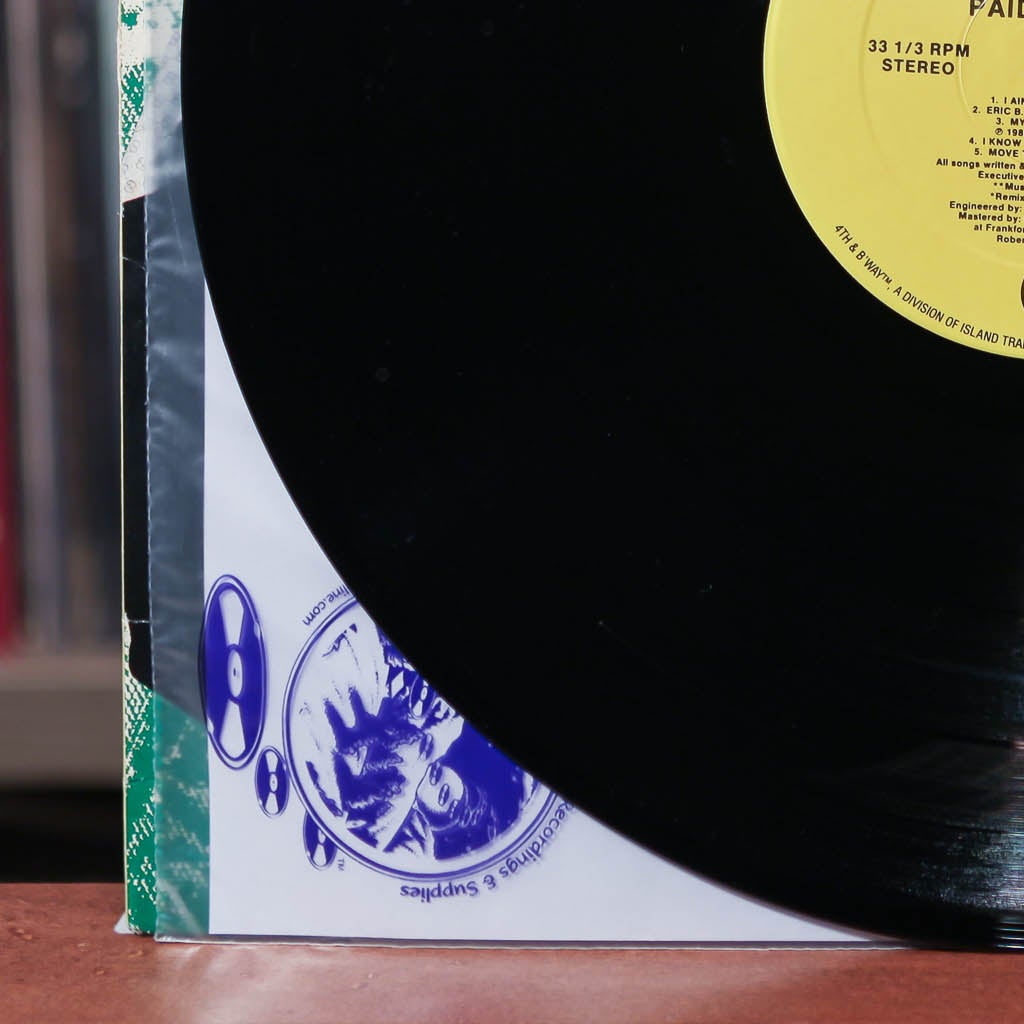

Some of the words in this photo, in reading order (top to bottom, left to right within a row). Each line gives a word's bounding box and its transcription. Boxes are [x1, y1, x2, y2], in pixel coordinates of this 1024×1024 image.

[868, 39, 887, 53] 33
[894, 40, 923, 55] 1/3
[930, 42, 969, 57] RPM
[882, 58, 954, 75] STEREO
[991, 95, 998, 104] 1.
[1004, 95, 1007, 105] I
[972, 104, 980, 114] 2.
[986, 104, 1010, 116] ERIC
[1014, 106, 1023, 116] B.
[995, 116, 1003, 126] 3.
[1010, 116, 1024, 127] MY
[969, 136, 976, 145] 4.
[982, 136, 985, 146] I
[989, 136, 1021, 147] KNOW
[974, 146, 982, 156] 5.
[988, 146, 1018, 158] MOVE
[935, 156, 948, 167] All
[951, 159, 980, 170] songs
[983, 159, 1015, 170] written
[1019, 161, 1024, 171] &
[977, 169, 1024, 181] Executive
[949, 199, 1004, 212] Engineered
[1007, 202, 1022, 215] by:
[958, 210, 1003, 222] Mastered
[1006, 213, 1020, 225] by:
[973, 222, 982, 232] at
[835, 225, 853, 244] 4TH
[849, 242, 859, 253] &
[893, 286, 903, 298] A
[902, 291, 945, 322] DIVISION
[945, 316, 960, 329] OF
[960, 322, 999, 344] ISLAND
[302, 585, 350, 626] line.com
[483, 874, 496, 890] &
[400, 880, 479, 903] Supplies
